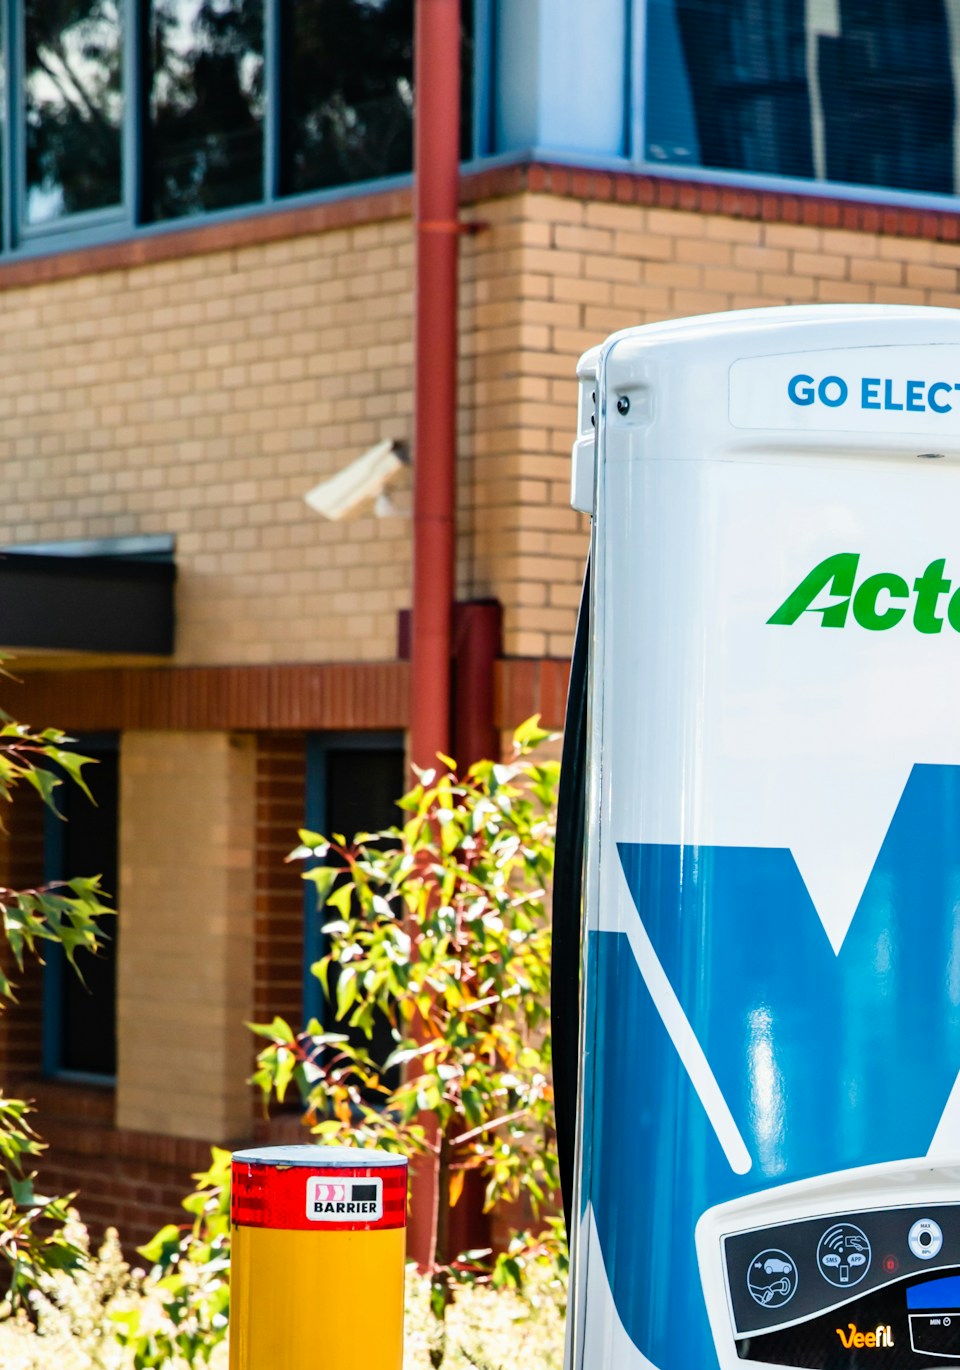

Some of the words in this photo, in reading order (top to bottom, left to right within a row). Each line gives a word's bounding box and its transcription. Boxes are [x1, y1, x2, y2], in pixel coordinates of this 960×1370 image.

[787, 374, 848, 408] GO
[314, 1202, 377, 1213] BARRIER
[825, 1256, 838, 1264] SMS
[850, 1255, 862, 1263] APP
[929, 1318, 941, 1326] MIN
